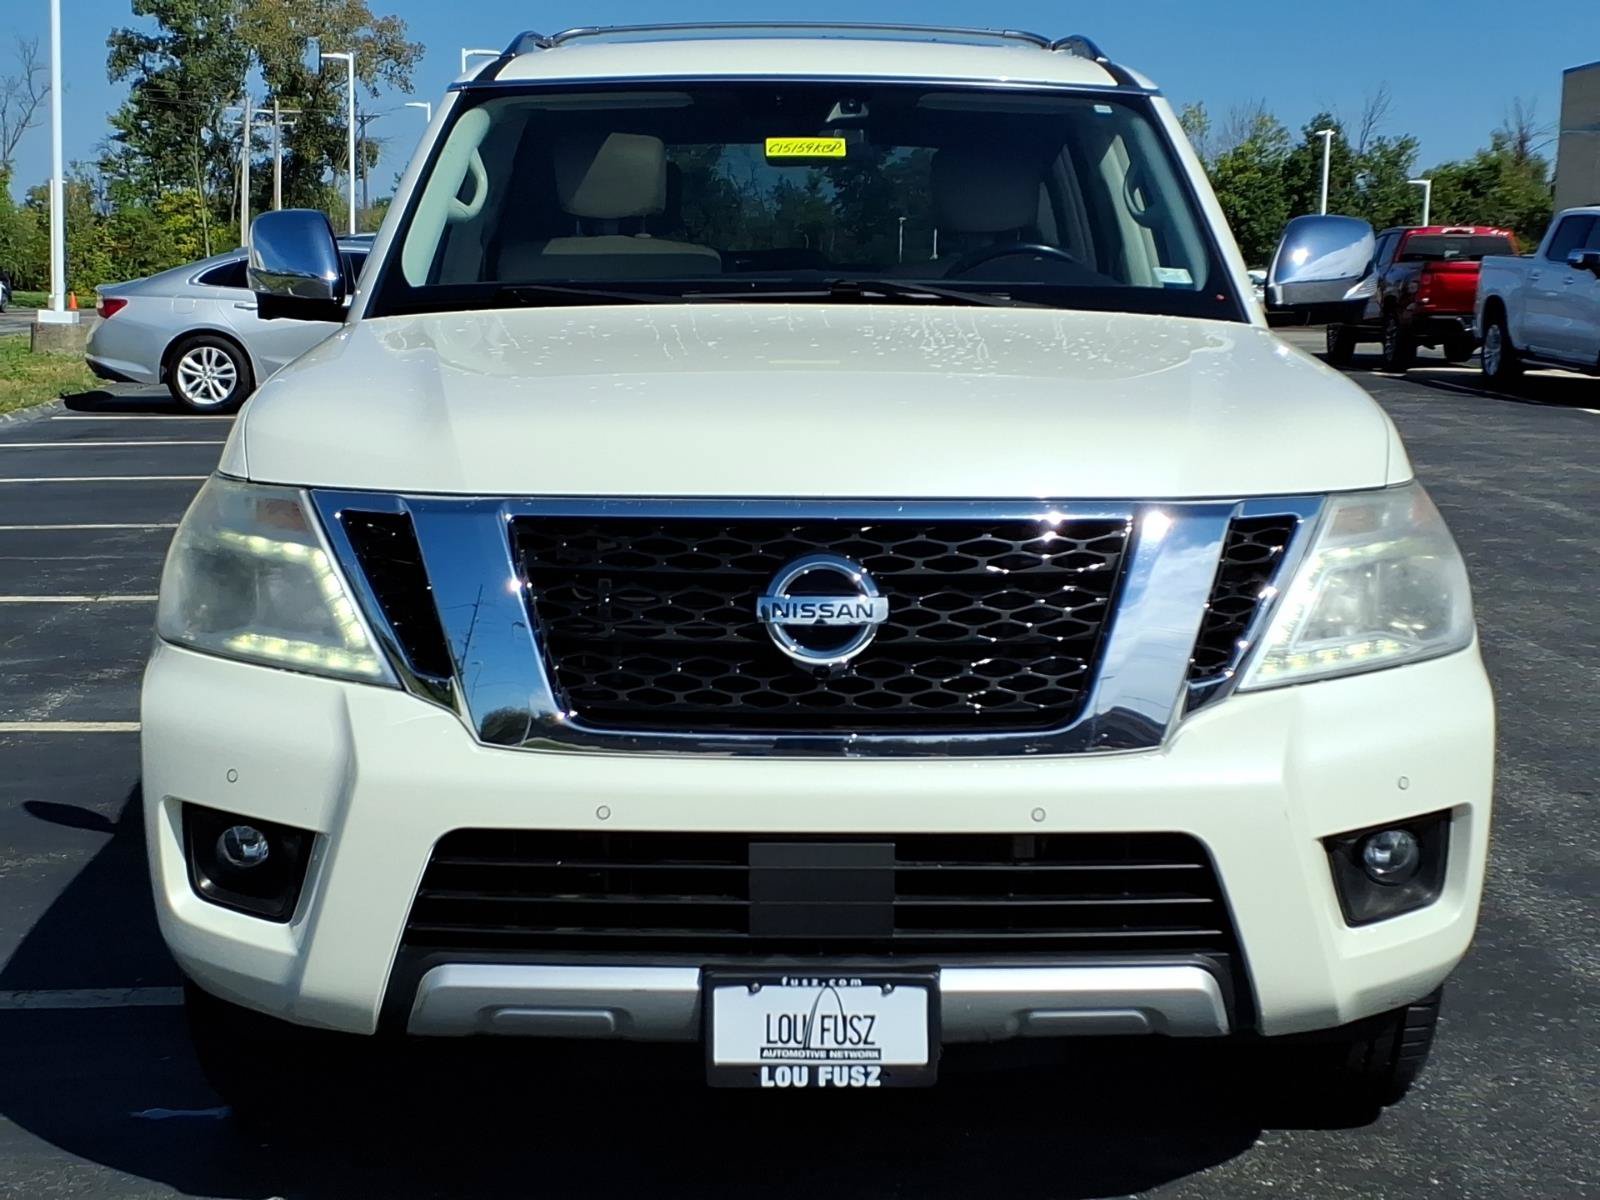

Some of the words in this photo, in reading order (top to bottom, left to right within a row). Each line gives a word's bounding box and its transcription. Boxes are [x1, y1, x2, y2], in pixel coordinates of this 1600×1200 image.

[772, 602, 873, 619] NISSAN
[781, 976, 863, 987] fusz.com
[766, 1014, 807, 1045] LOU
[820, 1014, 876, 1045] FUSZ
[762, 1049, 827, 1059] AUTOMOTIVE
[829, 1050, 880, 1060] NETWORK
[760, 1066, 809, 1088] LOU
[818, 1066, 882, 1088] FUSZ
